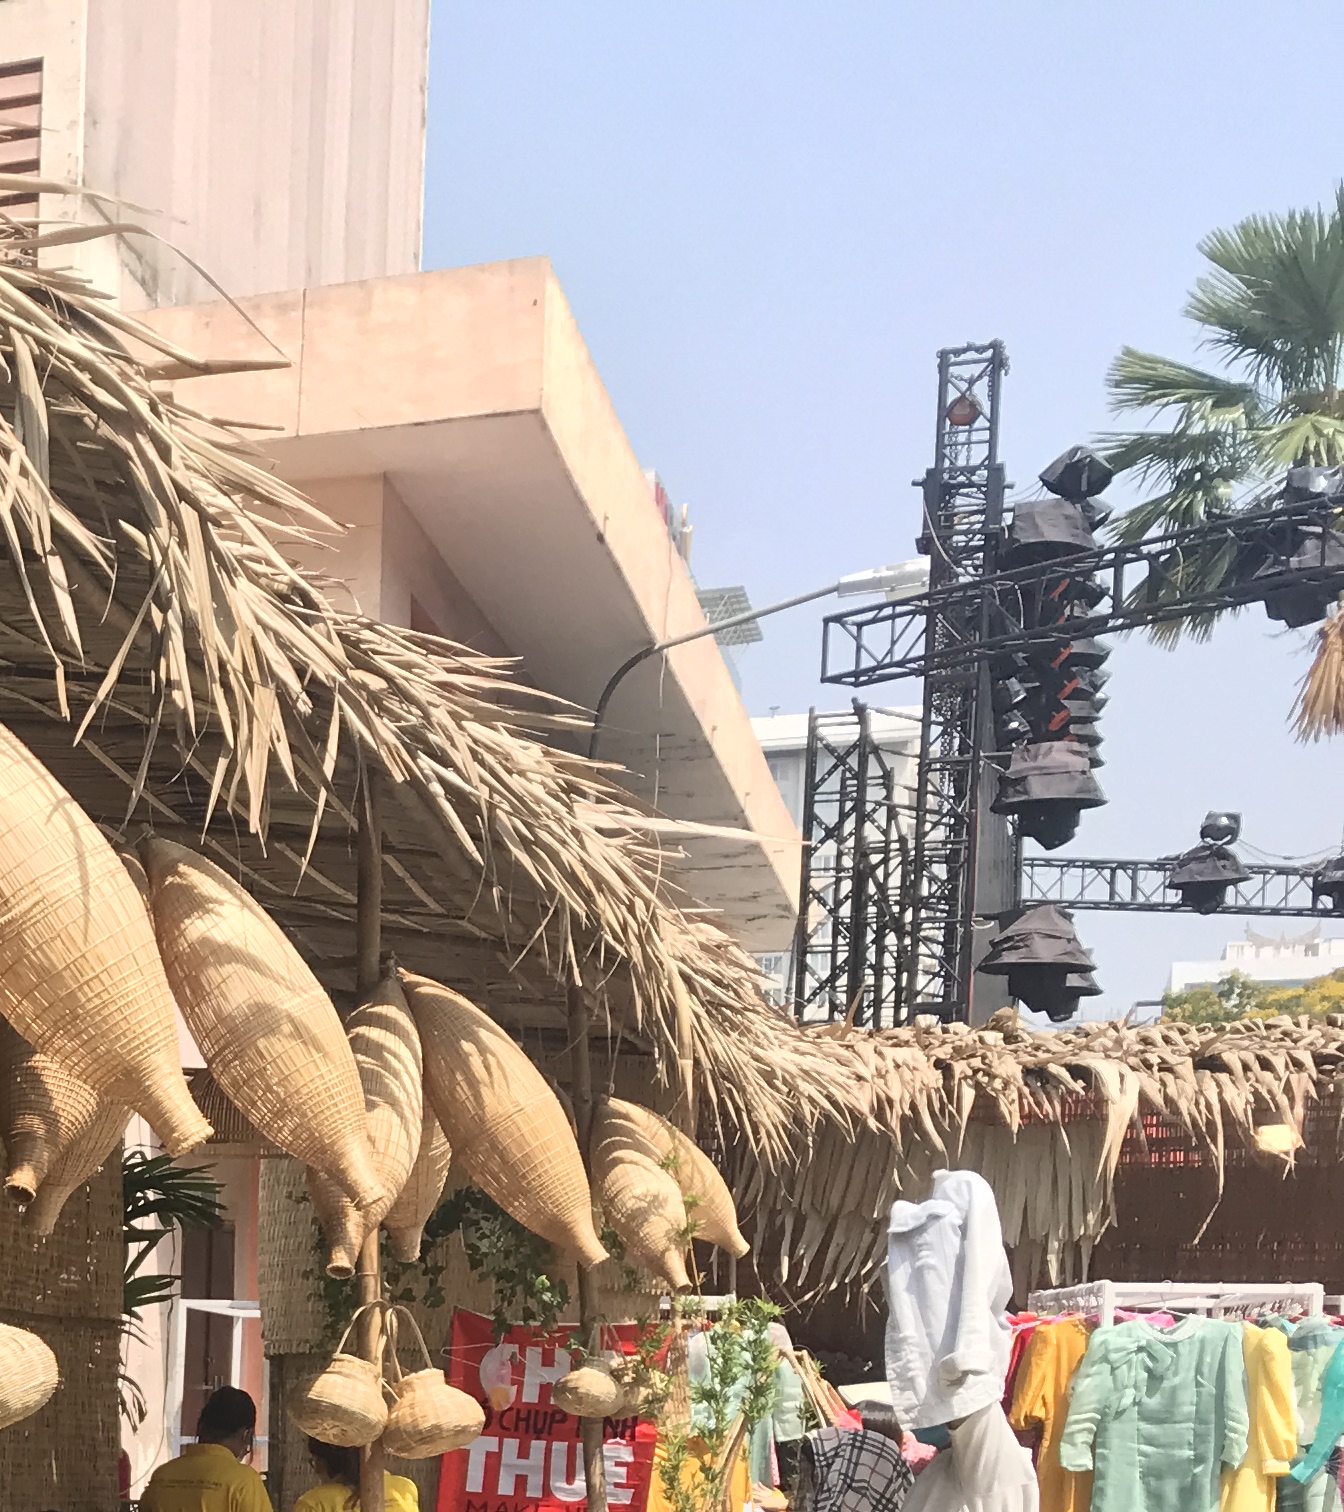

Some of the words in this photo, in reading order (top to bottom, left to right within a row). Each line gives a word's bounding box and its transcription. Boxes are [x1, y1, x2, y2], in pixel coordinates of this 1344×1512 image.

[479, 1344, 615, 1405] CH
[575, 1415, 639, 1441] NH
[459, 1435, 635, 1505] THUÊ
